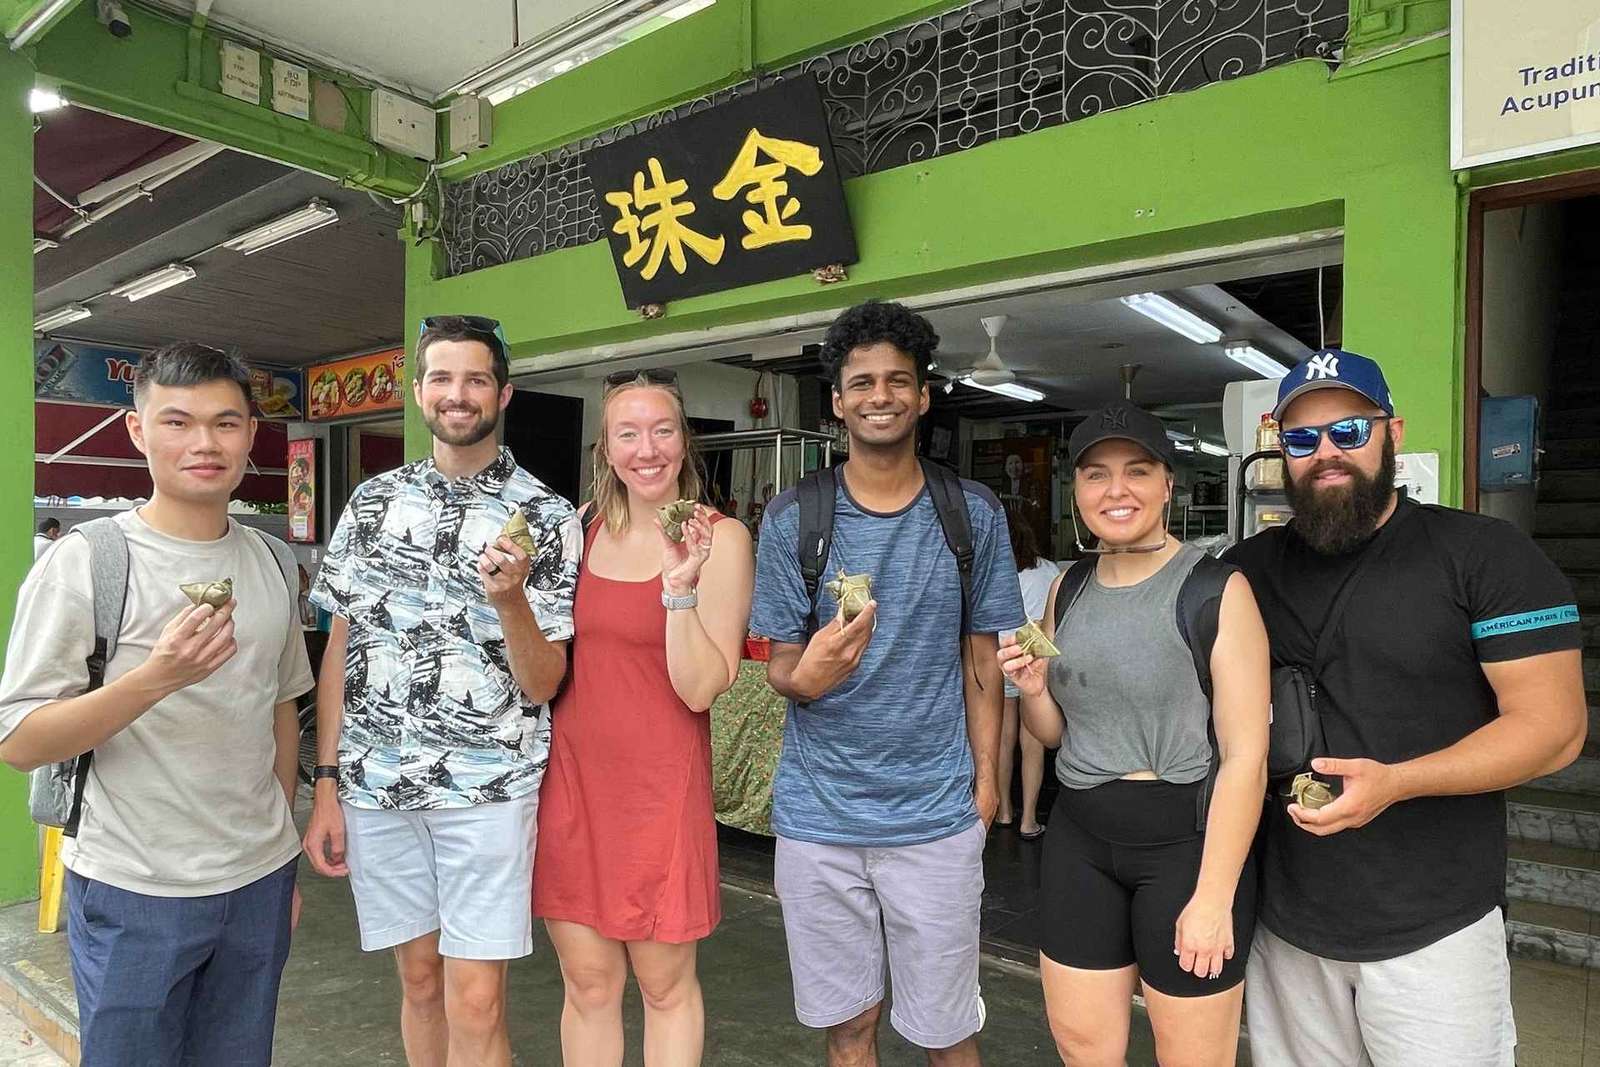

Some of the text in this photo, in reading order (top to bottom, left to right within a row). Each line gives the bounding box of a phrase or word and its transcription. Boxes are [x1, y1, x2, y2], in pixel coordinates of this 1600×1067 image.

[1305, 352, 1339, 380] NY
[1102, 407, 1127, 430] NY
[1534, 613, 1557, 625] PARIS
